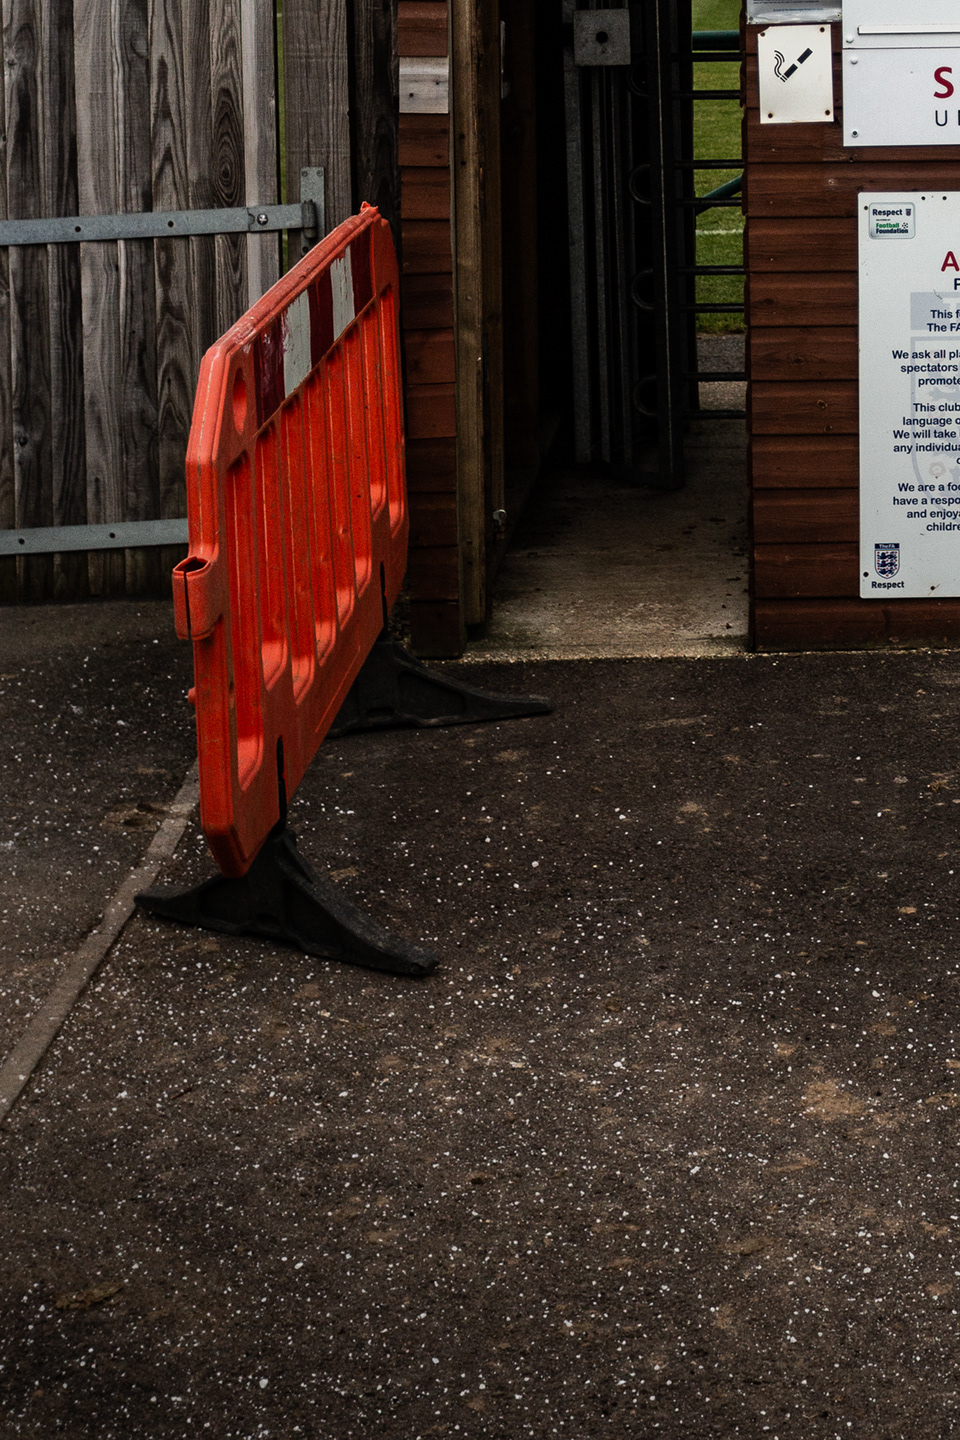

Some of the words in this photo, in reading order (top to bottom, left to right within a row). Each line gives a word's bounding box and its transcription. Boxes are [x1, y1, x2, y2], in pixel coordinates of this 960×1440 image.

[872, 208, 903, 217] Respect
[930, 309, 953, 319] This
[926, 322, 947, 332] The
[892, 350, 909, 359] We
[911, 350, 931, 359] ask
[933, 349, 946, 359] all
[900, 363, 958, 374] spectators
[912, 403, 936, 412] This
[902, 416, 952, 428] language
[892, 430, 910, 439] We
[912, 429, 931, 439] will
[933, 429, 957, 439] take
[893, 445, 913, 455] any
[898, 482, 915, 492] We
[917, 484, 936, 492] are
[938, 484, 945, 492] a
[893, 496, 918, 505] have
[906, 509, 927, 519] and
[871, 581, 905, 590] Respect
